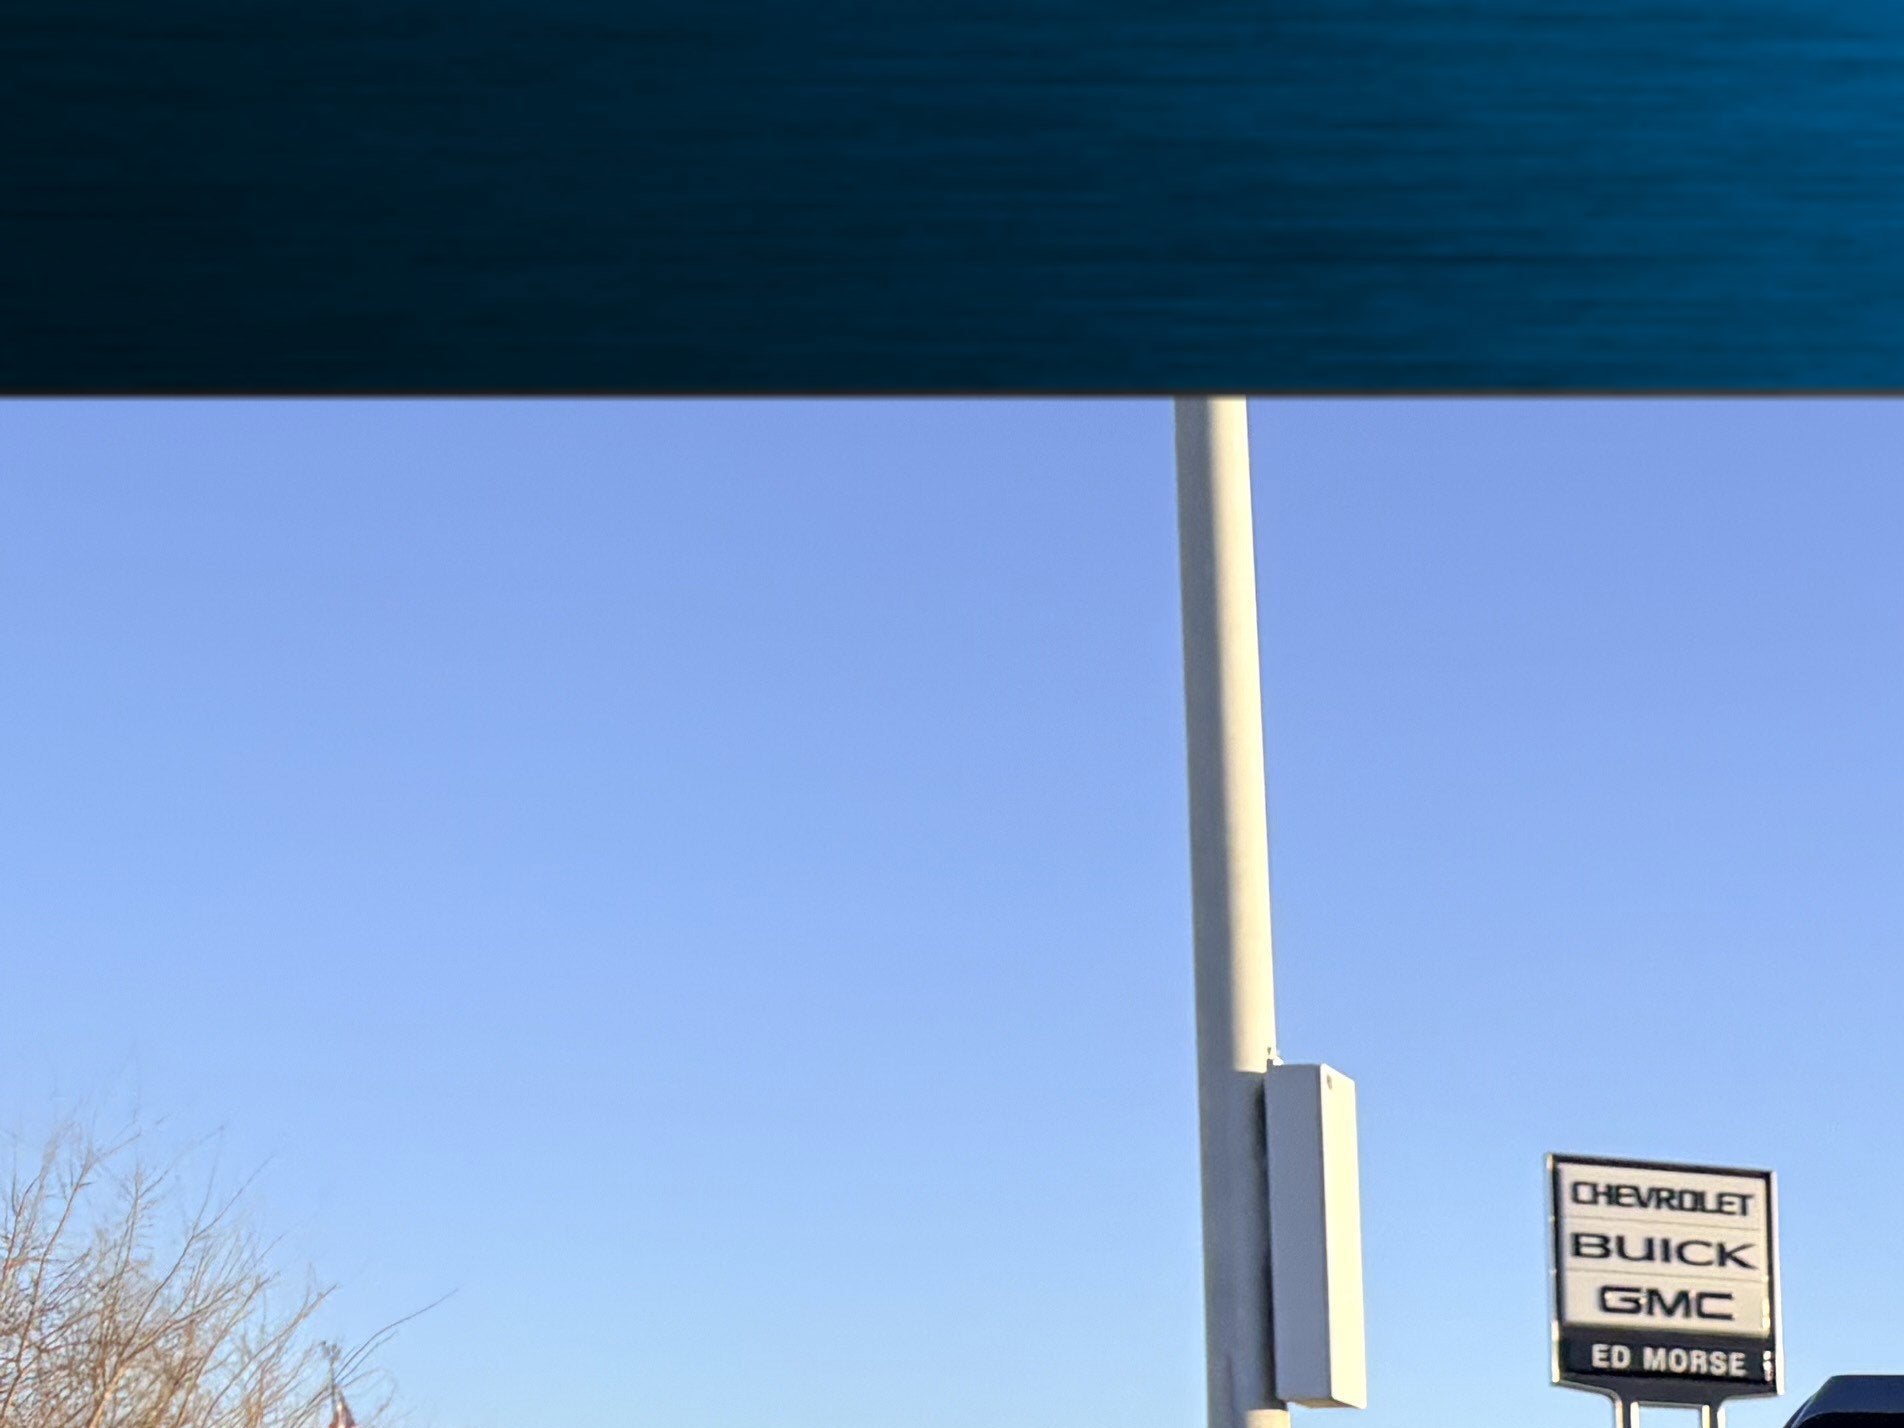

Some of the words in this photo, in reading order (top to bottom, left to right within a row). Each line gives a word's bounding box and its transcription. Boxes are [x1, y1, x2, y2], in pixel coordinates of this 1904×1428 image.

[1571, 1181, 1755, 1216] CHEVROLET
[1570, 1233, 1757, 1270] BUICK
[1601, 1285, 1734, 1320] GMC
[1591, 1344, 1631, 1370] ED
[1643, 1347, 1747, 1376] MORSE
